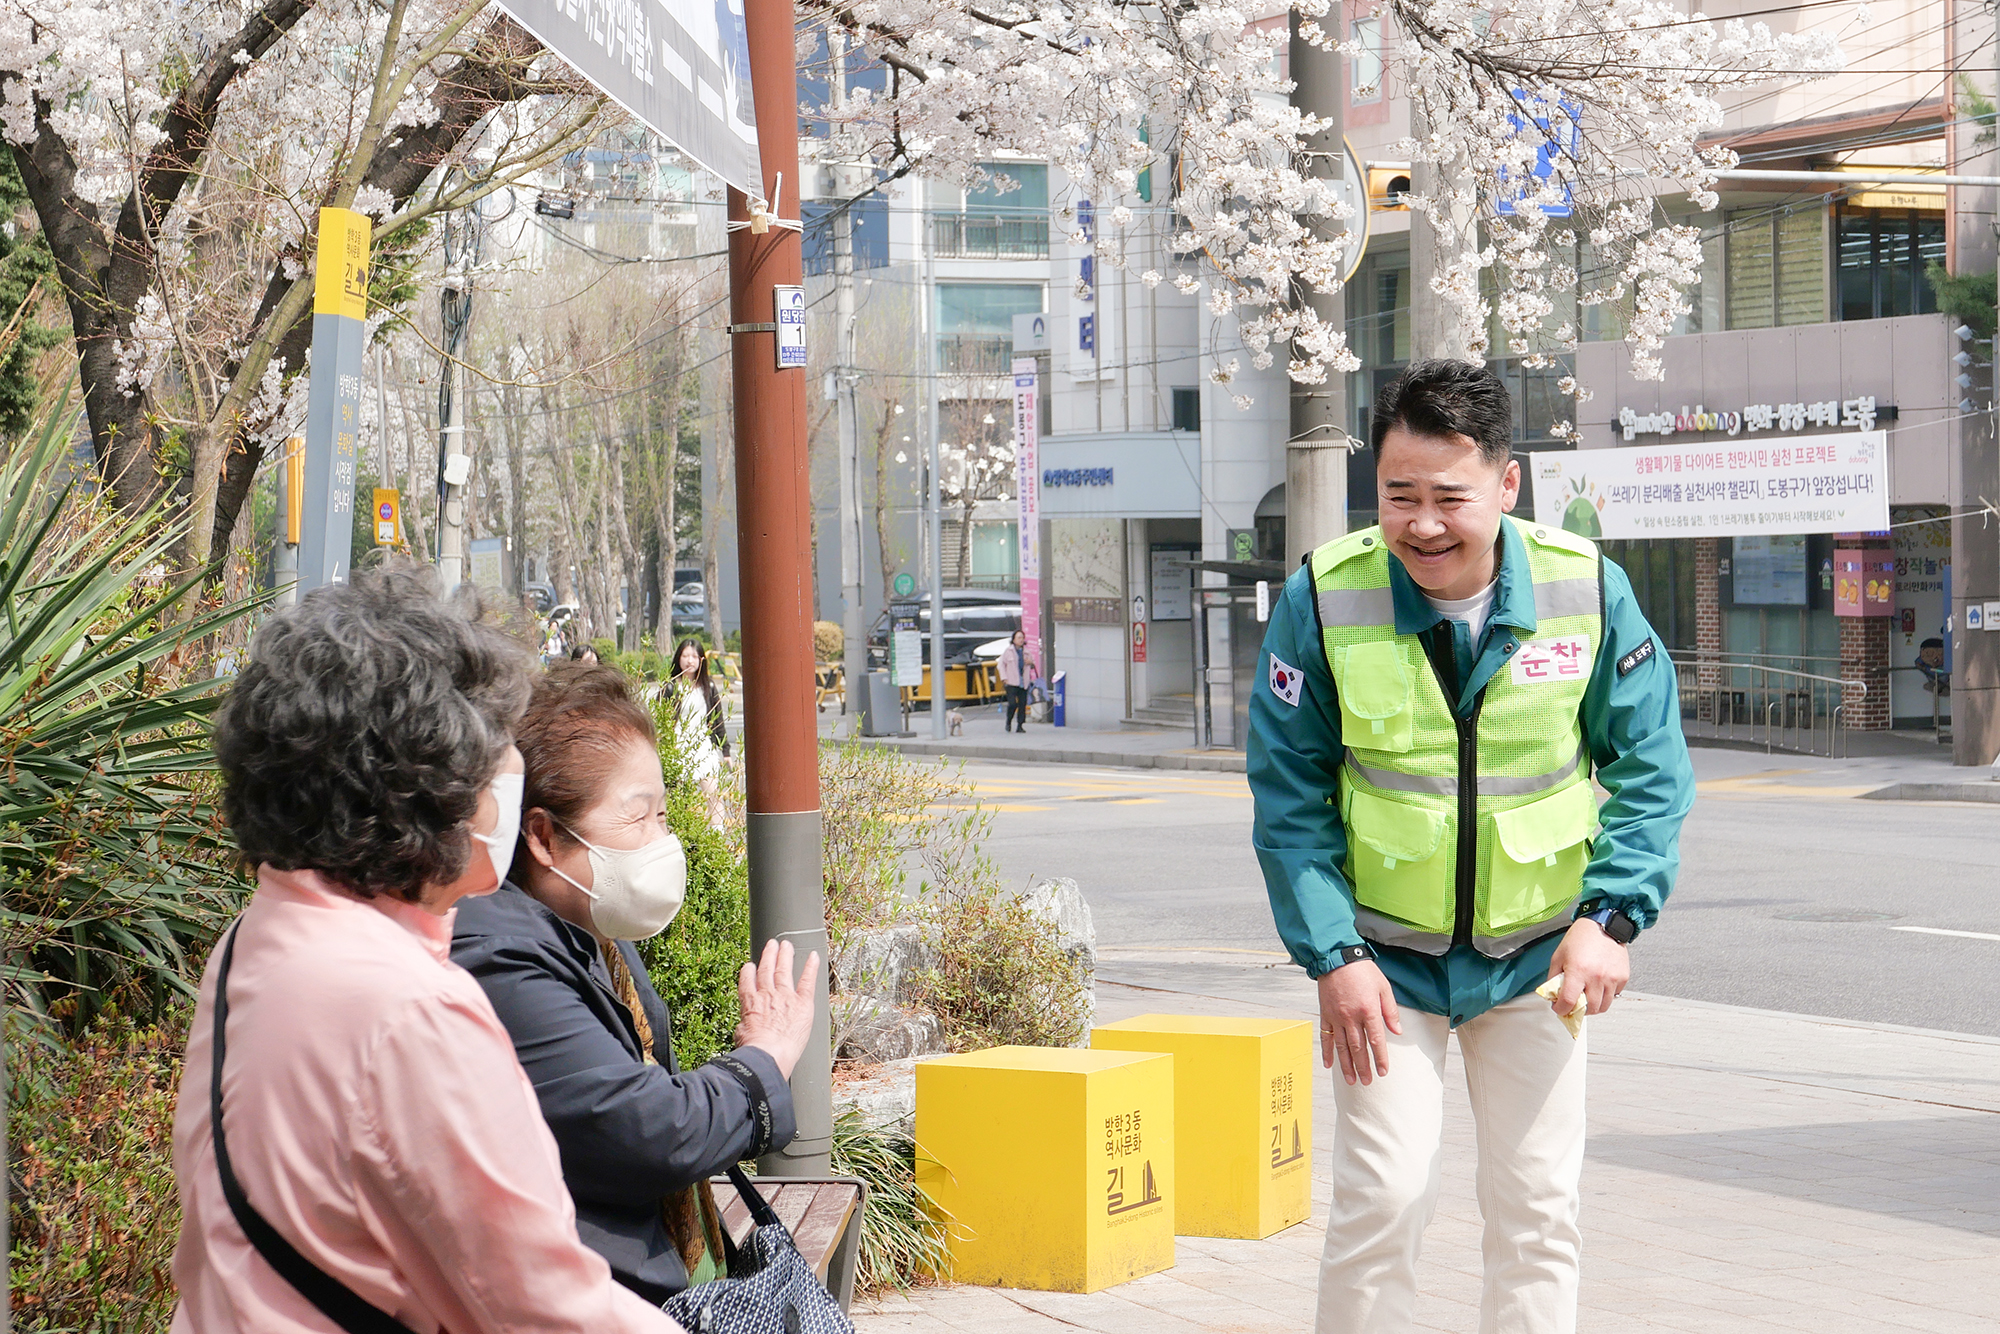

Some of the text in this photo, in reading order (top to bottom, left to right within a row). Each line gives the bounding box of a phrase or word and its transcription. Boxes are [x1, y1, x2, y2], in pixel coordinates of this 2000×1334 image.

[796, 325, 802, 345] 1
[339, 373, 359, 400] 방학3동
[342, 403, 353, 427] 역사
[1674, 404, 1741, 436] dobong
[1840, 395, 1877, 432] 도봉
[337, 431, 354, 457] 문화길
[335, 460, 352, 485] 시작점
[1635, 454, 1682, 475] 생활폐기물
[1685, 451, 1724, 471] 다이어트
[1727, 449, 1767, 470] 천만시민
[1771, 447, 1791, 467] 실천
[1795, 445, 1837, 464] 프로젝트
[333, 488, 350, 513] 입니다
[1642, 482, 1682, 503] 분리배출
[1684, 480, 1725, 502] 실천서약
[1767, 477, 1810, 499] 도봉구가
[1812, 474, 1874, 497] 앞장섭니다!
[1643, 516, 1656, 527] 일상
[1664, 515, 1688, 527] 탄소중립
[1758, 511, 1791, 524] 줄이기부터
[1793, 509, 1836, 522] 시작해보세요!
[1520, 641, 1582, 678] 순찰
[1623, 642, 1652, 670] 서울 도봉구
[1270, 1072, 1293, 1098] 방학3동
[1270, 1093, 1293, 1118] 역사문화
[1104, 1109, 1142, 1138] 방학3동
[1104, 1132, 1142, 1161] 역사문화
